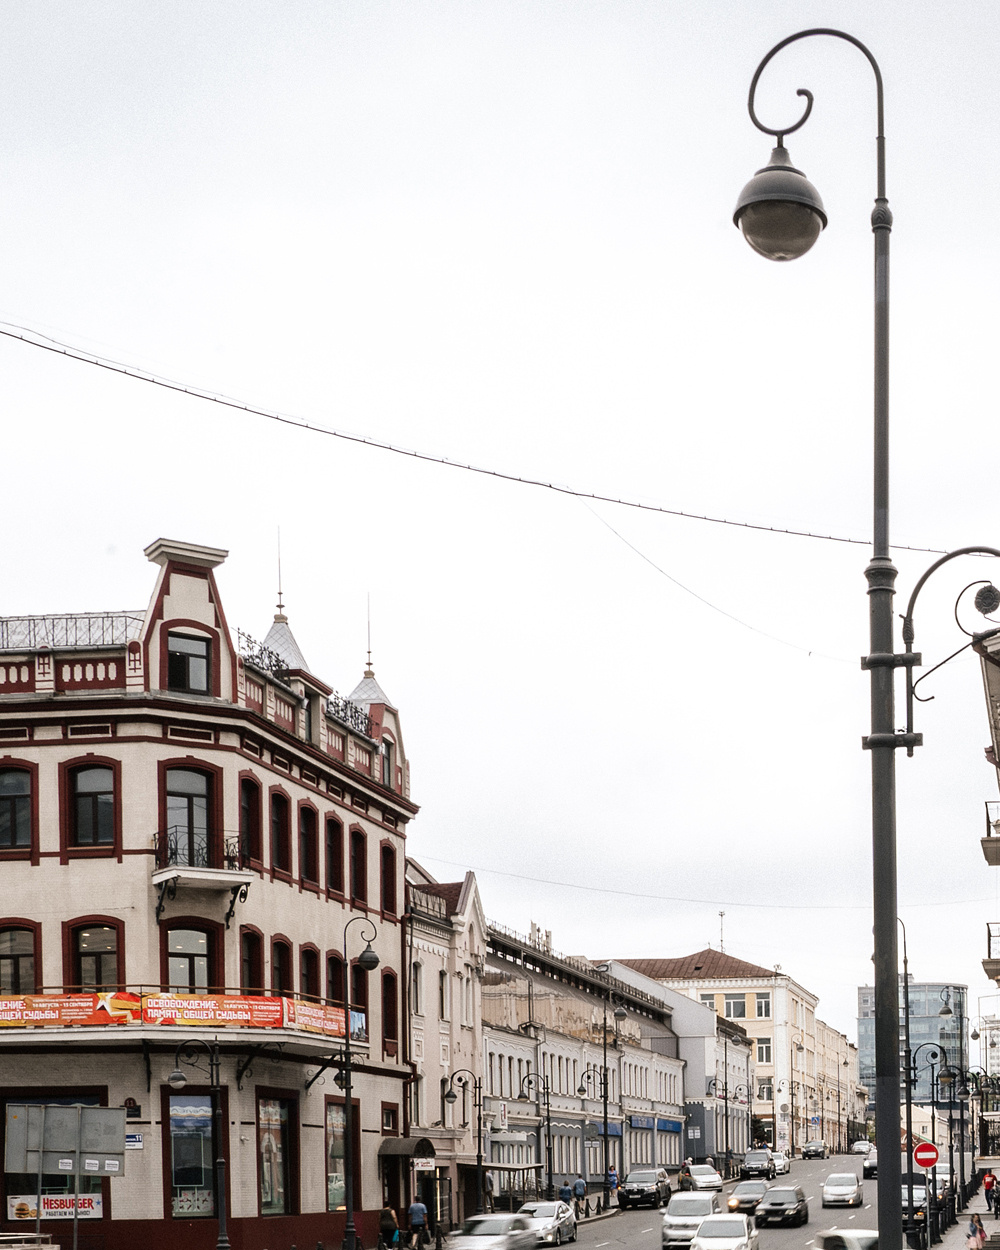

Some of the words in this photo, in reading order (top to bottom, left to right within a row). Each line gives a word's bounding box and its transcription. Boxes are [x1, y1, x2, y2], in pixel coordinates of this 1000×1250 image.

[147, 998, 219, 1009] ОСВОБОЖДЕНИЕ:
[23, 1011, 58, 1020] СУДЬБЫ
[147, 1009, 182, 1018] ПАМЯТЬ
[183, 1009, 214, 1020] ОБЩЕЙ
[215, 1011, 250, 1020] СУДЬБЫ
